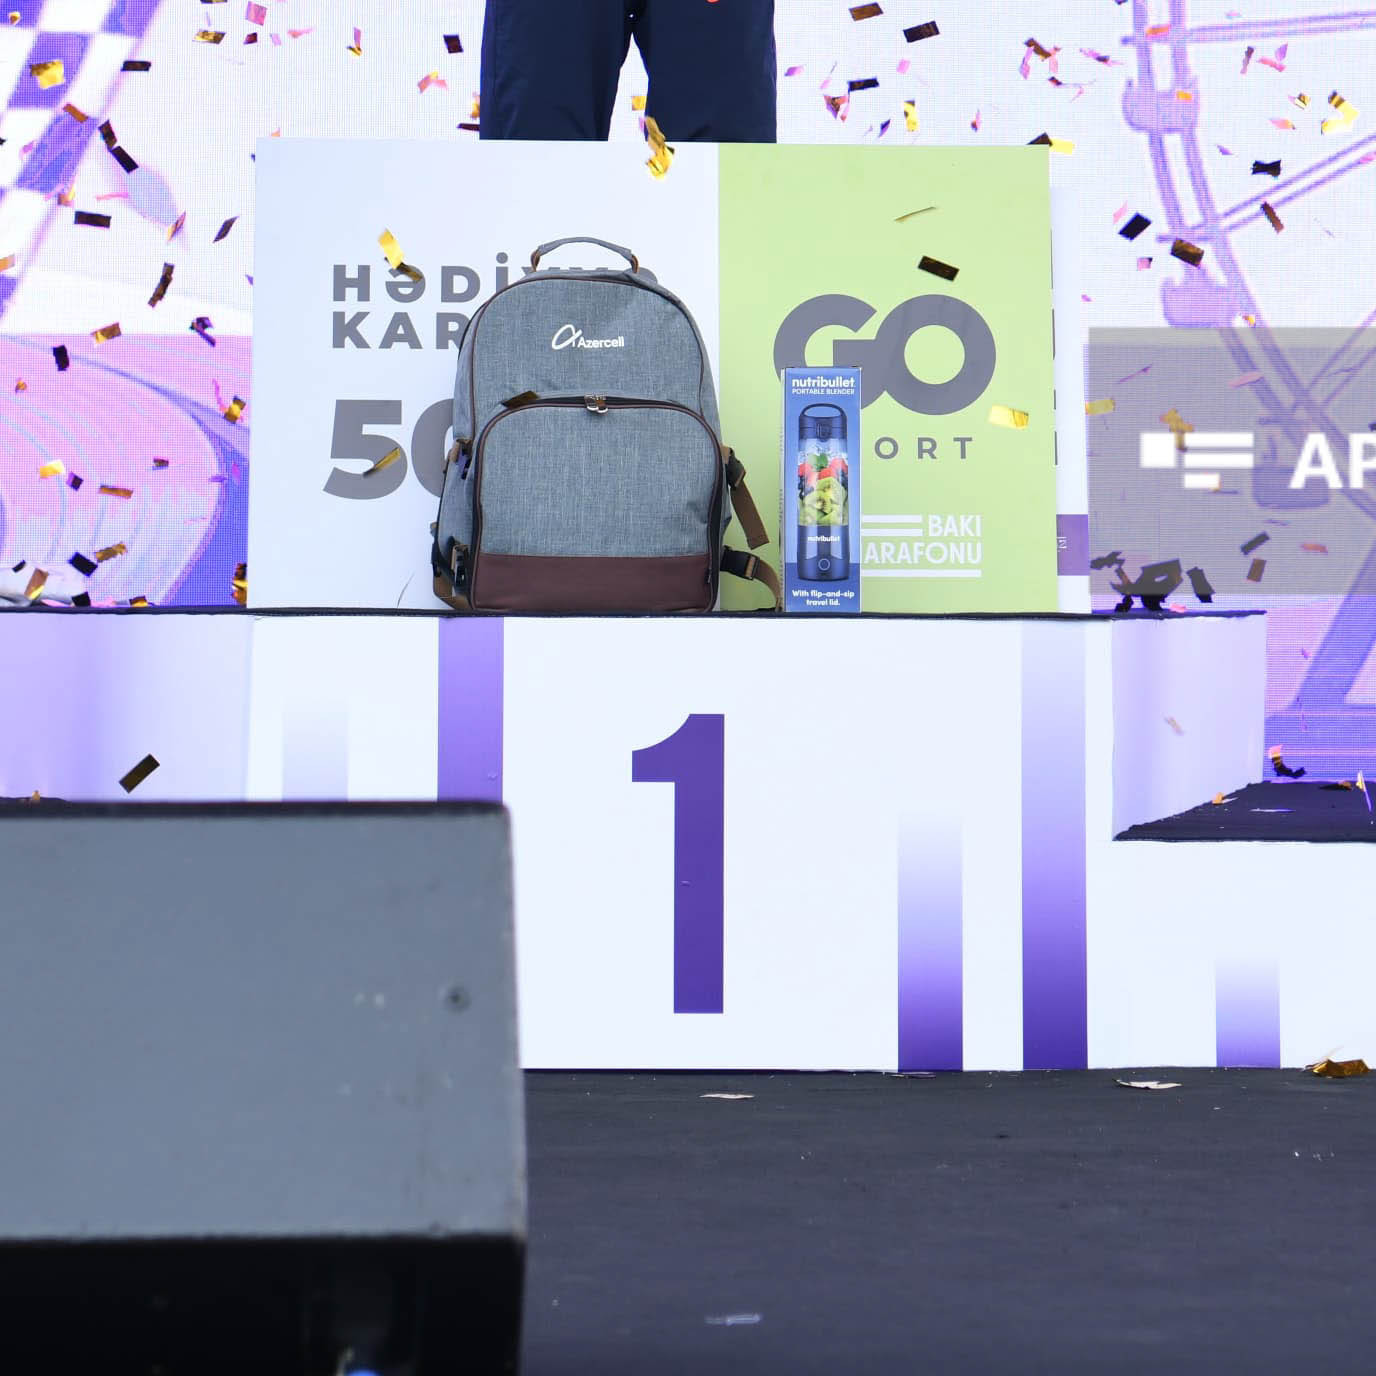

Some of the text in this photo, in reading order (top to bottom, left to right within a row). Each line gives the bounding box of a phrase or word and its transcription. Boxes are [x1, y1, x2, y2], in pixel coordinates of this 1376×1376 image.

[332, 311, 471, 350] KAR
[577, 336, 625, 348] Azercell
[791, 376, 856, 388] nutribullet
[928, 514, 982, 537] BAKI
[864, 542, 983, 565] ARAFONU
[632, 714, 724, 1013] 1
